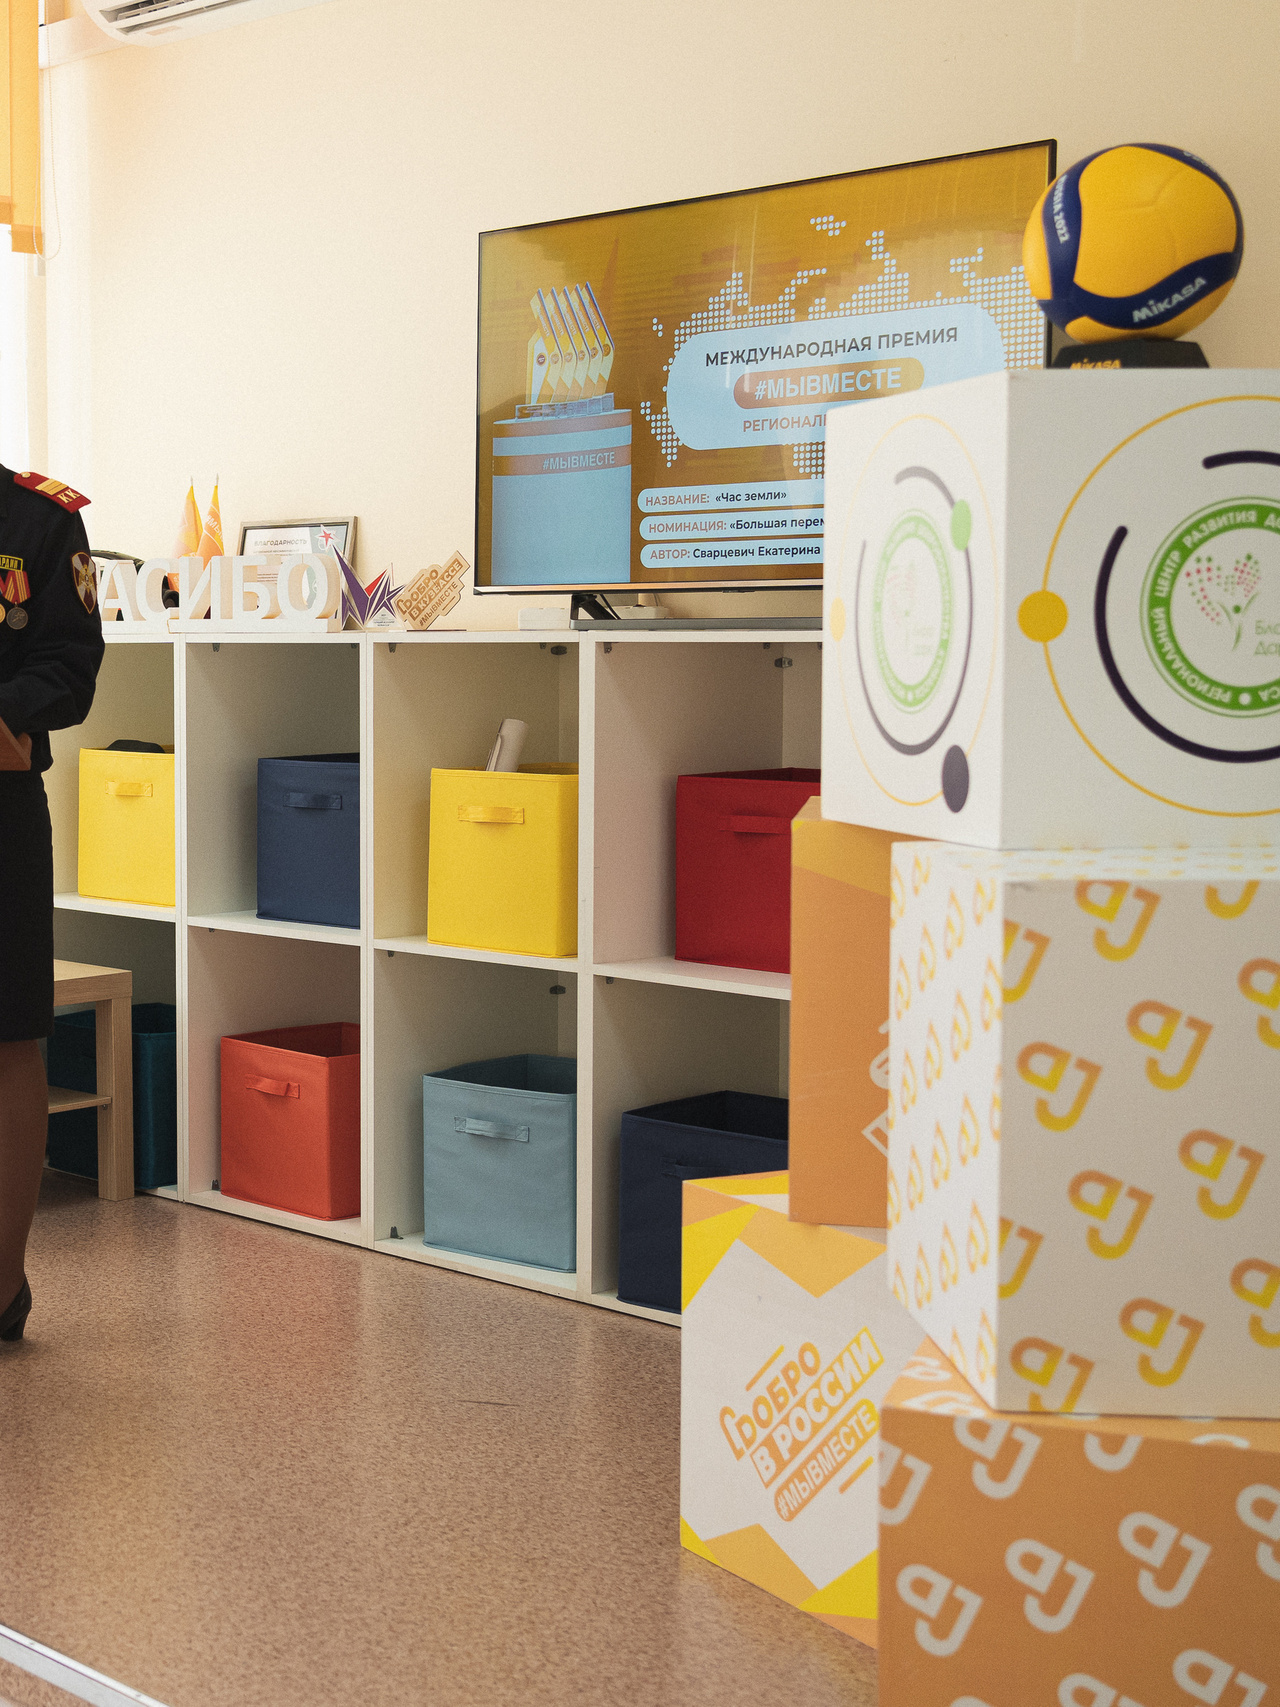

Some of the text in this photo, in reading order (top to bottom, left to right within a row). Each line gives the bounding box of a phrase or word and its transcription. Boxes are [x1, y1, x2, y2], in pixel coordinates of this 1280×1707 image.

[1054, 211, 1070, 244] 2022
[706, 326, 958, 367] МЕЖДУНАРОДНАЯ ПРЕМИЯ
[754, 366, 902, 400] #МЫВМЕСТЕ
[542, 452, 616, 470] #МЫВМЕСТЕ
[645, 490, 787, 506] НАЗВАНИЕ: «Час земли»
[648, 521, 727, 534] НОМИНАЦИЯ:
[730, 518, 788, 530] «Большая
[1182, 510, 1257, 548] РАЗВИТИЯ
[650, 544, 821, 560] АВТОР: Сварцевич Екатерина
[1154, 550, 1181, 598] ЦЕНТР
[420, 581, 458, 626] #МЫВМЕСТЕ
[1150, 608, 1232, 704] РЕГИОНАЛЬНЫЙ
[754, 1332, 880, 1486] В РОССИИ
[776, 1405, 876, 1520] #МЫВМЕСТЕ
